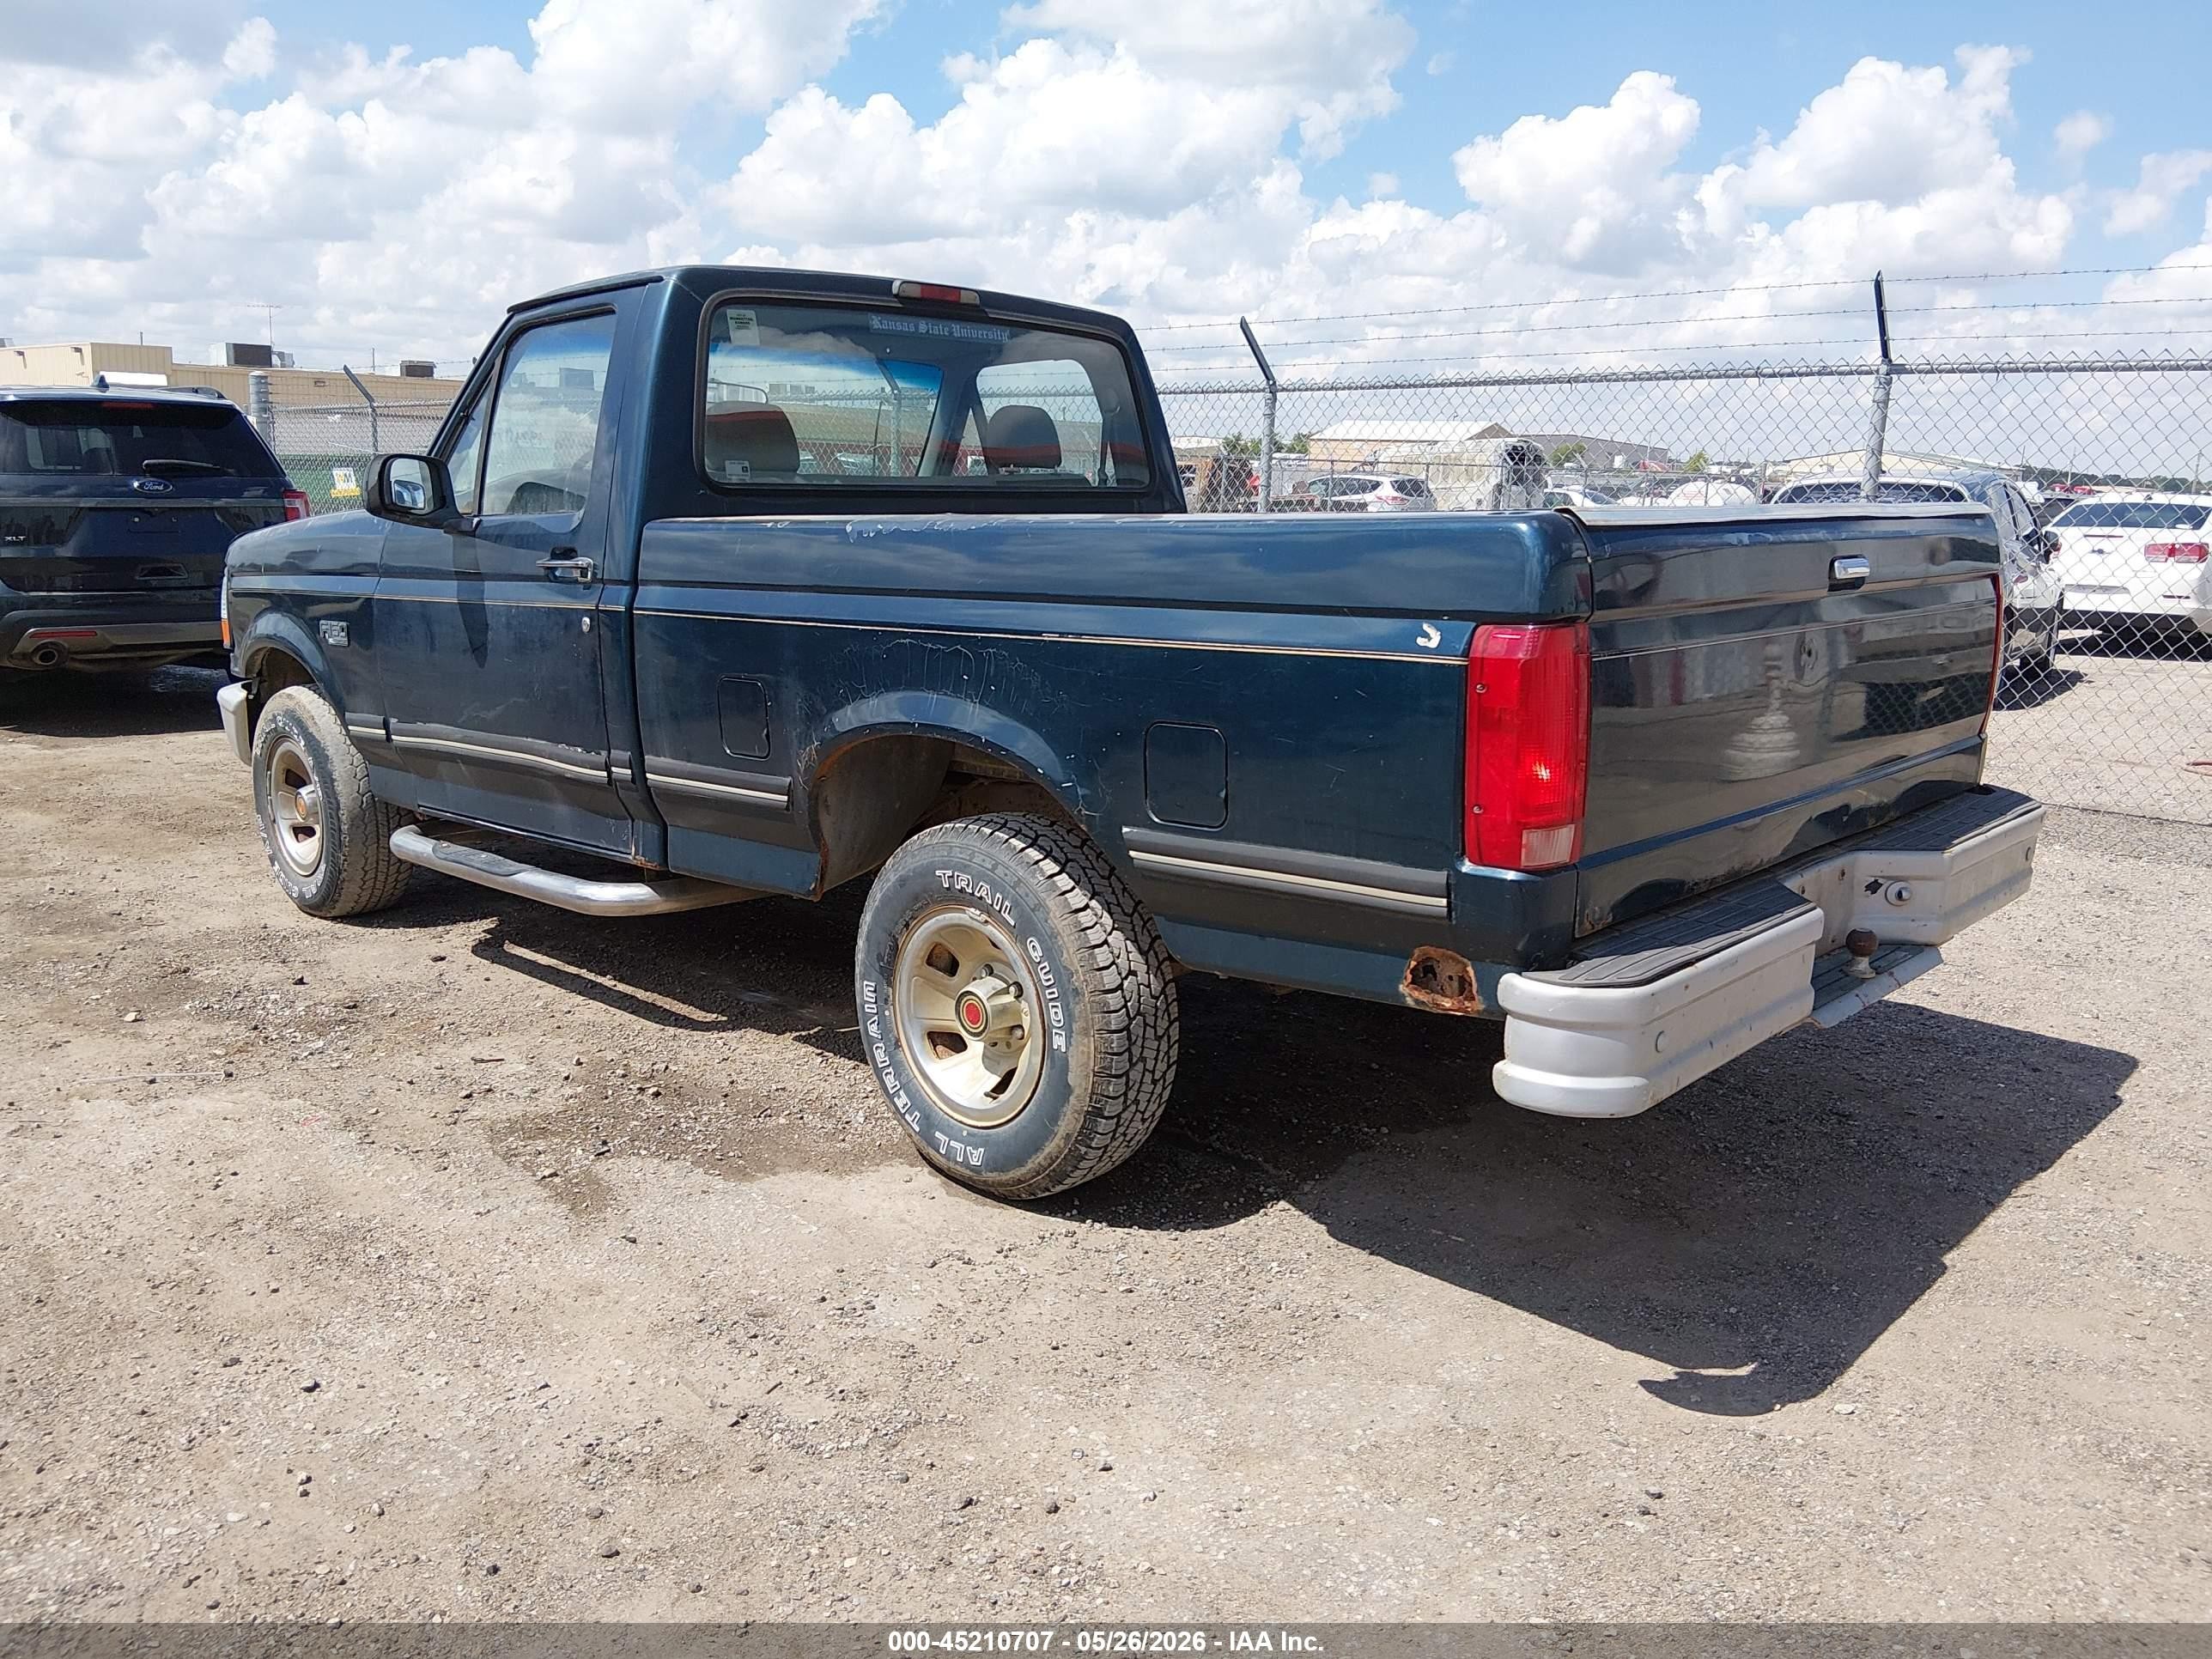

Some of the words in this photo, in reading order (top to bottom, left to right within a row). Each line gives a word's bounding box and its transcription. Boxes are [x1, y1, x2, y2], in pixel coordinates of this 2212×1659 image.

[869, 315, 915, 332] Kansas
[918, 320, 950, 336] State
[951, 324, 1012, 343] University
[143, 481, 165, 491] Ford
[935, 869, 1018, 928] TRAIL
[1025, 936, 1066, 1053] GUIDE
[862, 981, 921, 1133] TERRAIN
[934, 1130, 986, 1167] ALL
